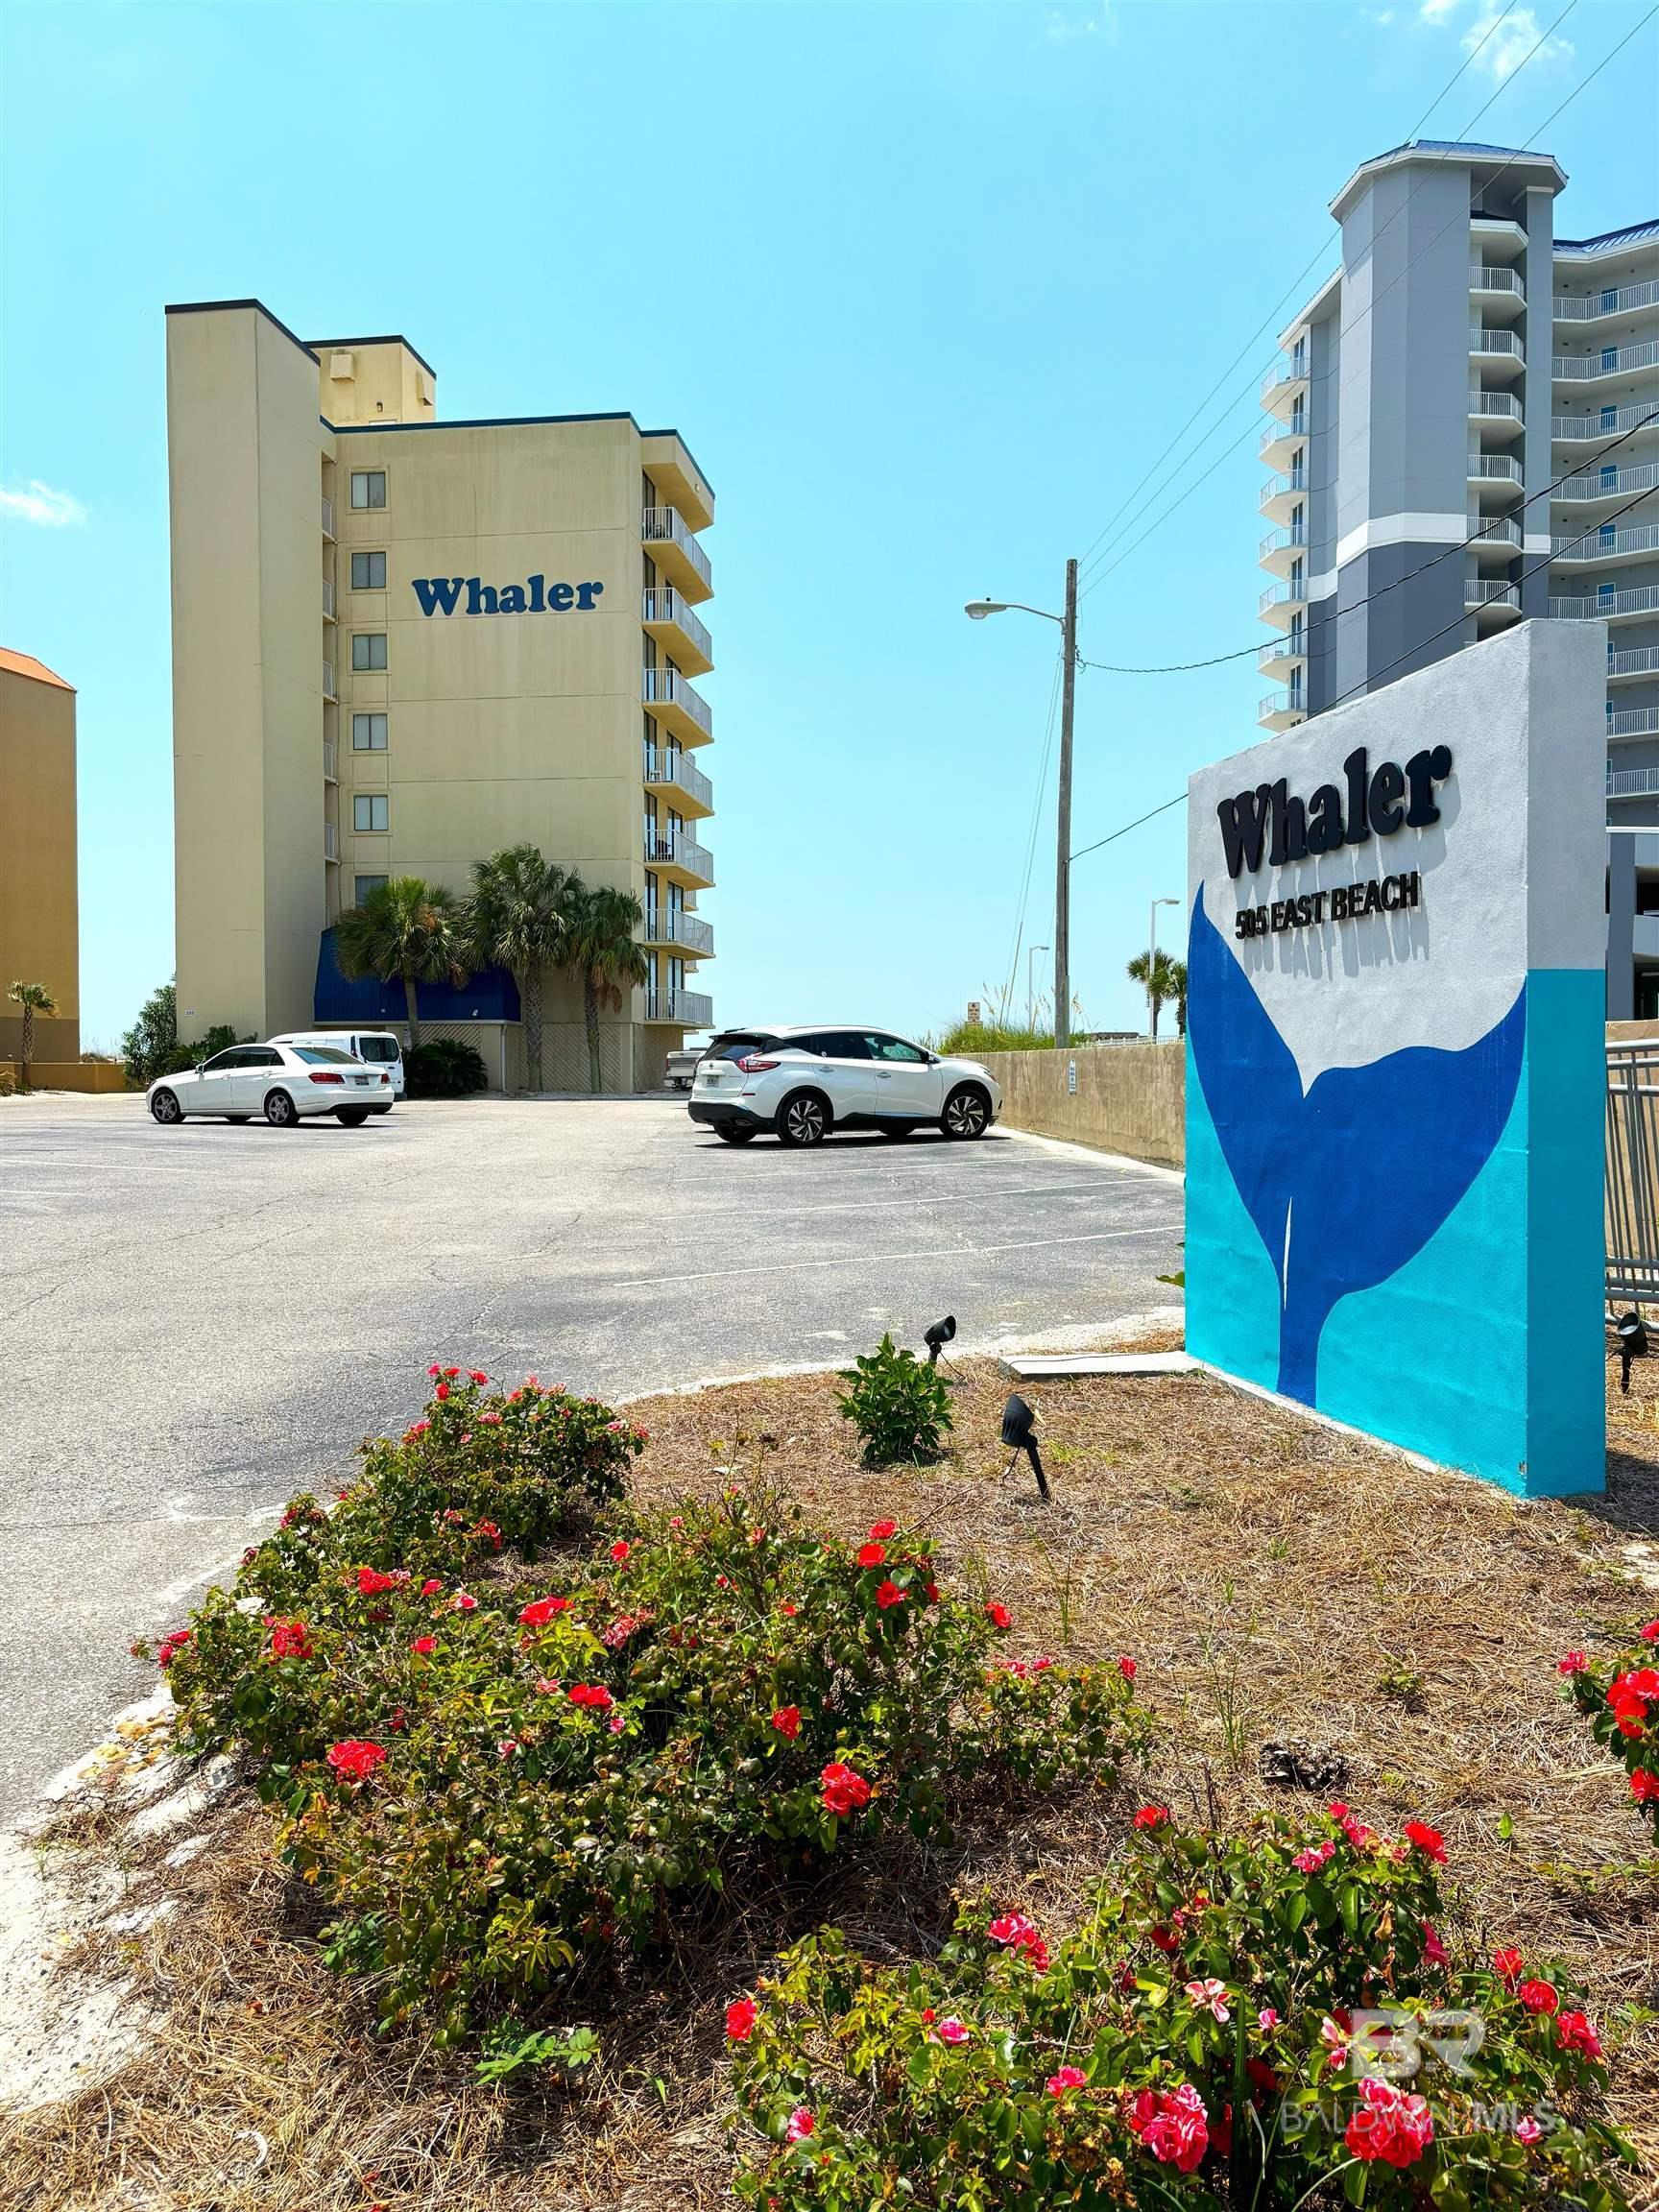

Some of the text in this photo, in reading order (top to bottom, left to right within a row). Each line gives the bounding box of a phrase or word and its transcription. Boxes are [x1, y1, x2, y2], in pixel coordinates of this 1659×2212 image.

[411, 574, 605, 617] Whaler
[1216, 744, 1453, 878] Whaler
[1235, 870, 1421, 940] 505 EAST BEACH
